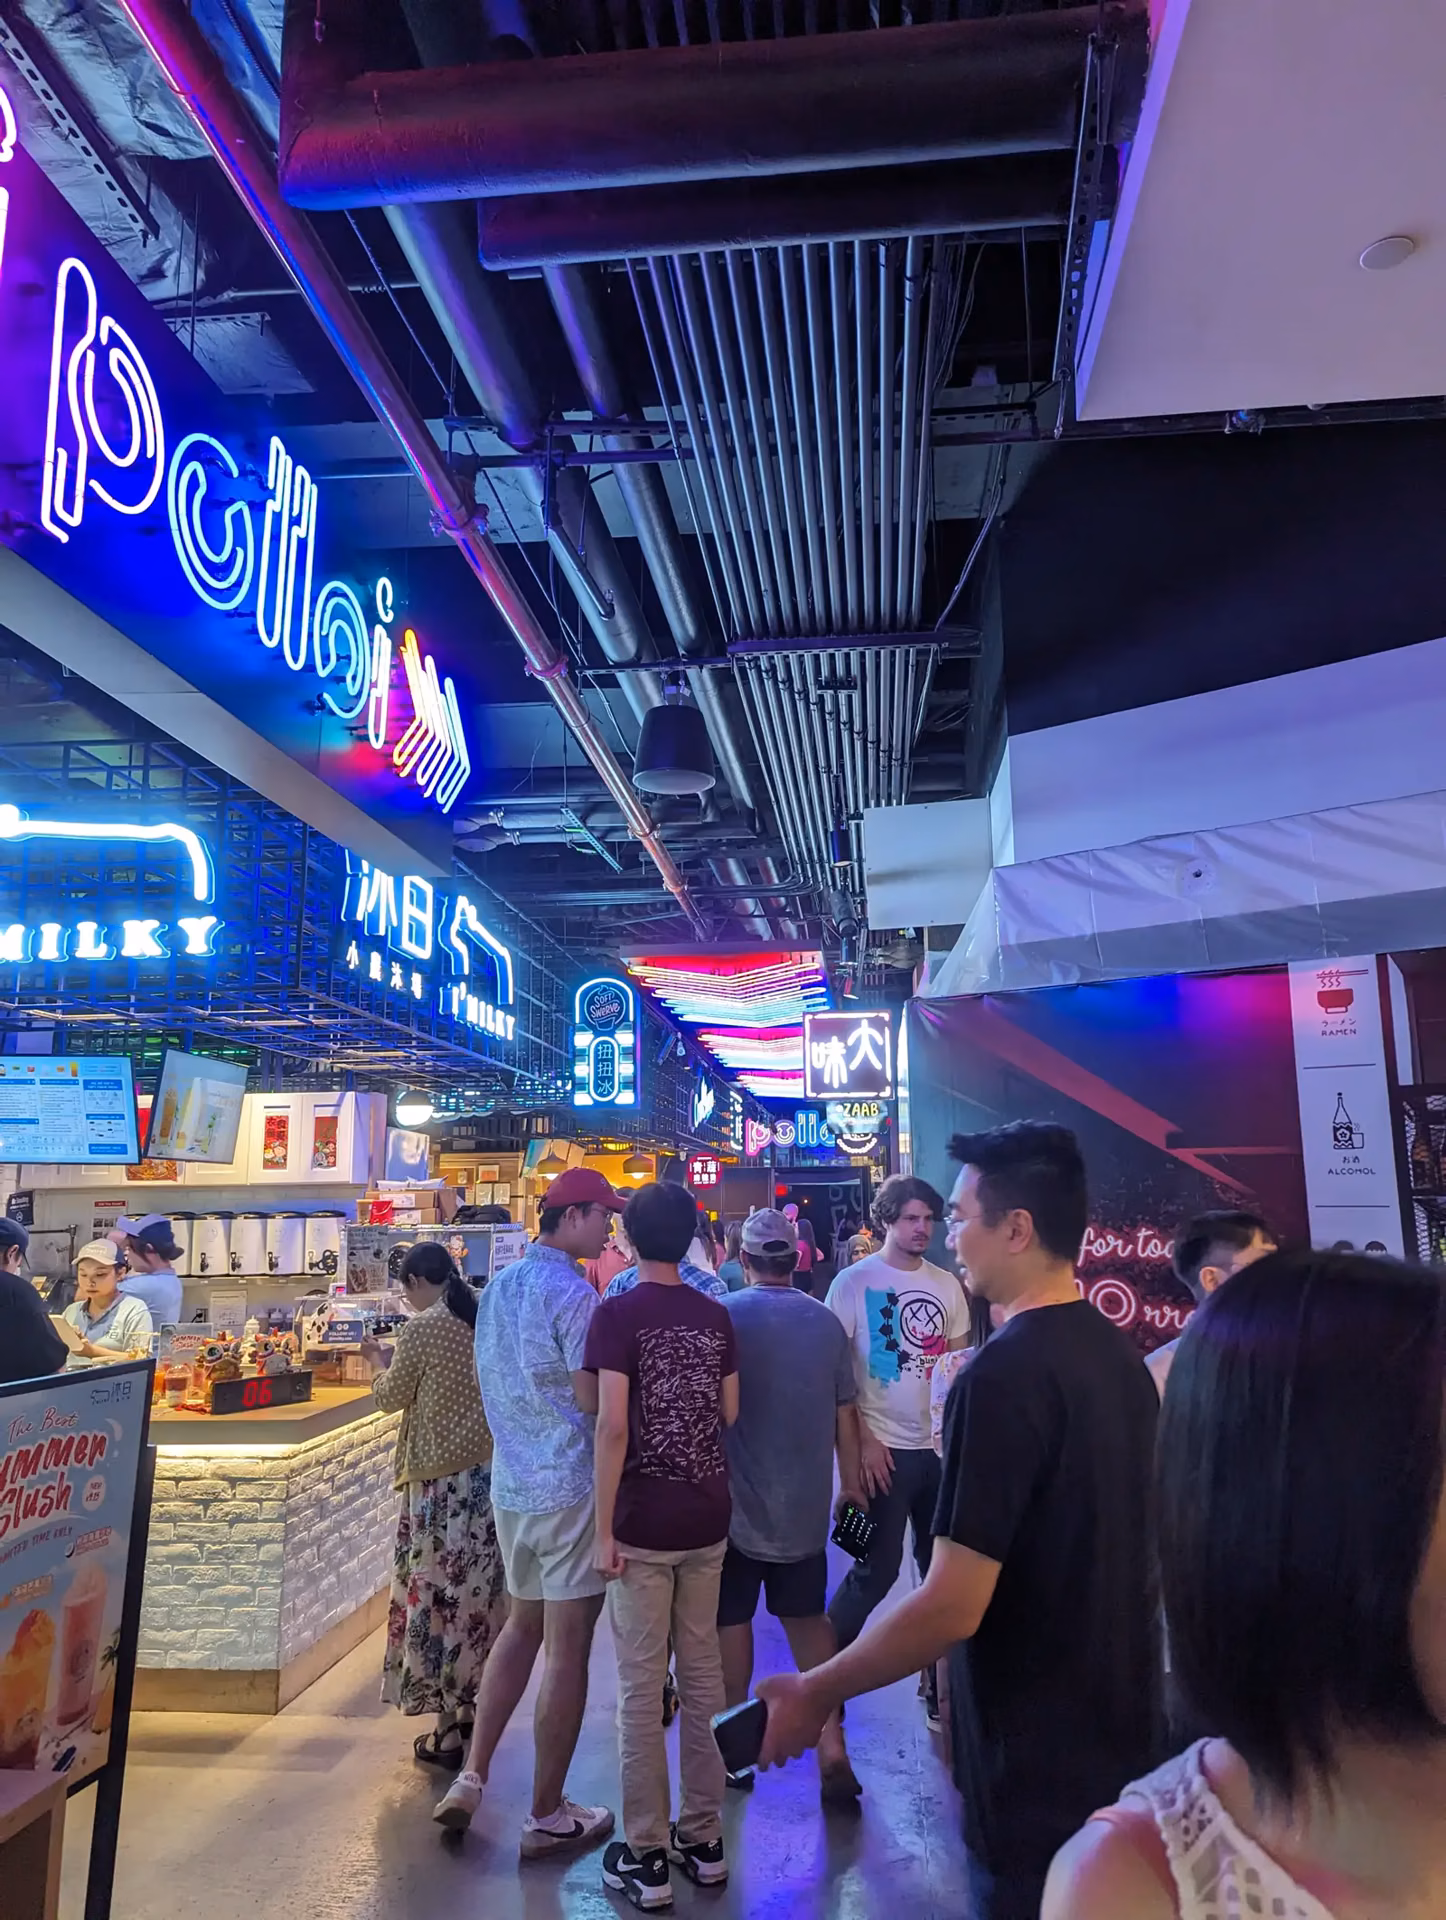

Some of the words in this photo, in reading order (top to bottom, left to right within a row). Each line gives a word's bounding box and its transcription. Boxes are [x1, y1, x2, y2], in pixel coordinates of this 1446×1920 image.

[1321, 1028, 1357, 1036] RAMEN
[597, 1044, 613, 1095] 扭扭冰
[843, 1102, 879, 1117] ZAAB
[1077, 1226, 1134, 1267] for
[241, 1379, 273, 1408] 06
[8, 1415, 34, 1444] The
[40, 1406, 79, 1433] Best
